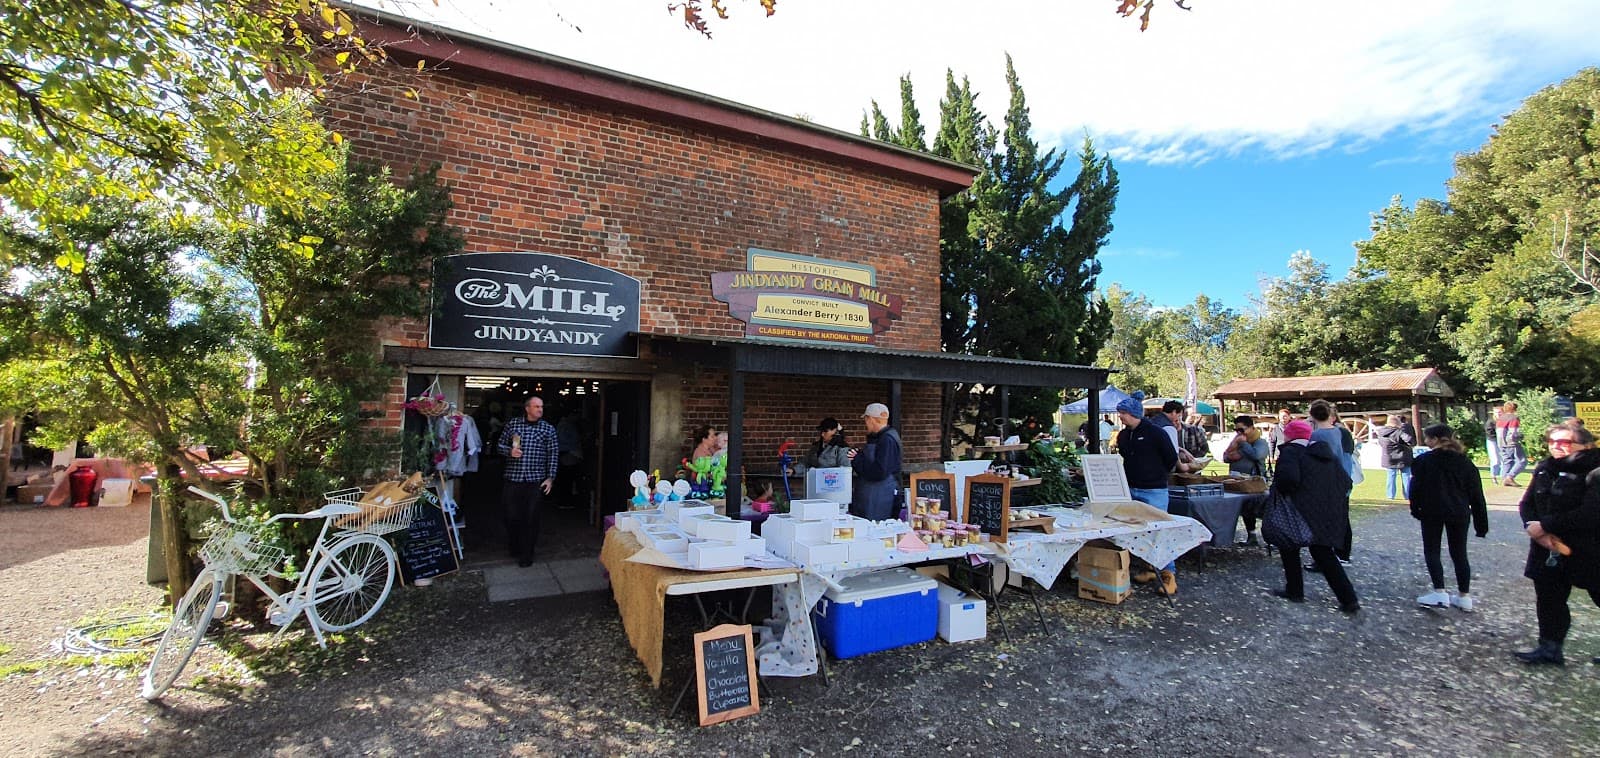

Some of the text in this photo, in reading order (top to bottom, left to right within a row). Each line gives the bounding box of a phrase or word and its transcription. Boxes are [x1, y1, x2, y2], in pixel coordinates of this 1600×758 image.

[792, 263, 839, 276] HISTORIC
[729, 273, 891, 308] JINDYANDY GRAIN MILL
[463, 282, 626, 322] The MILL
[792, 298, 839, 309] CONVICT BUILT
[764, 305, 864, 322] Alexander Berry 1830
[474, 325, 604, 346] JINDYANDY
[758, 327, 796, 337] CLASSIFIED
[797, 330, 807, 338] BY
[808, 331, 820, 339] THE
[821, 332, 850, 341] NATIONAL
[710, 640, 738, 649] Menu
[705, 655, 739, 671] Vanilla
